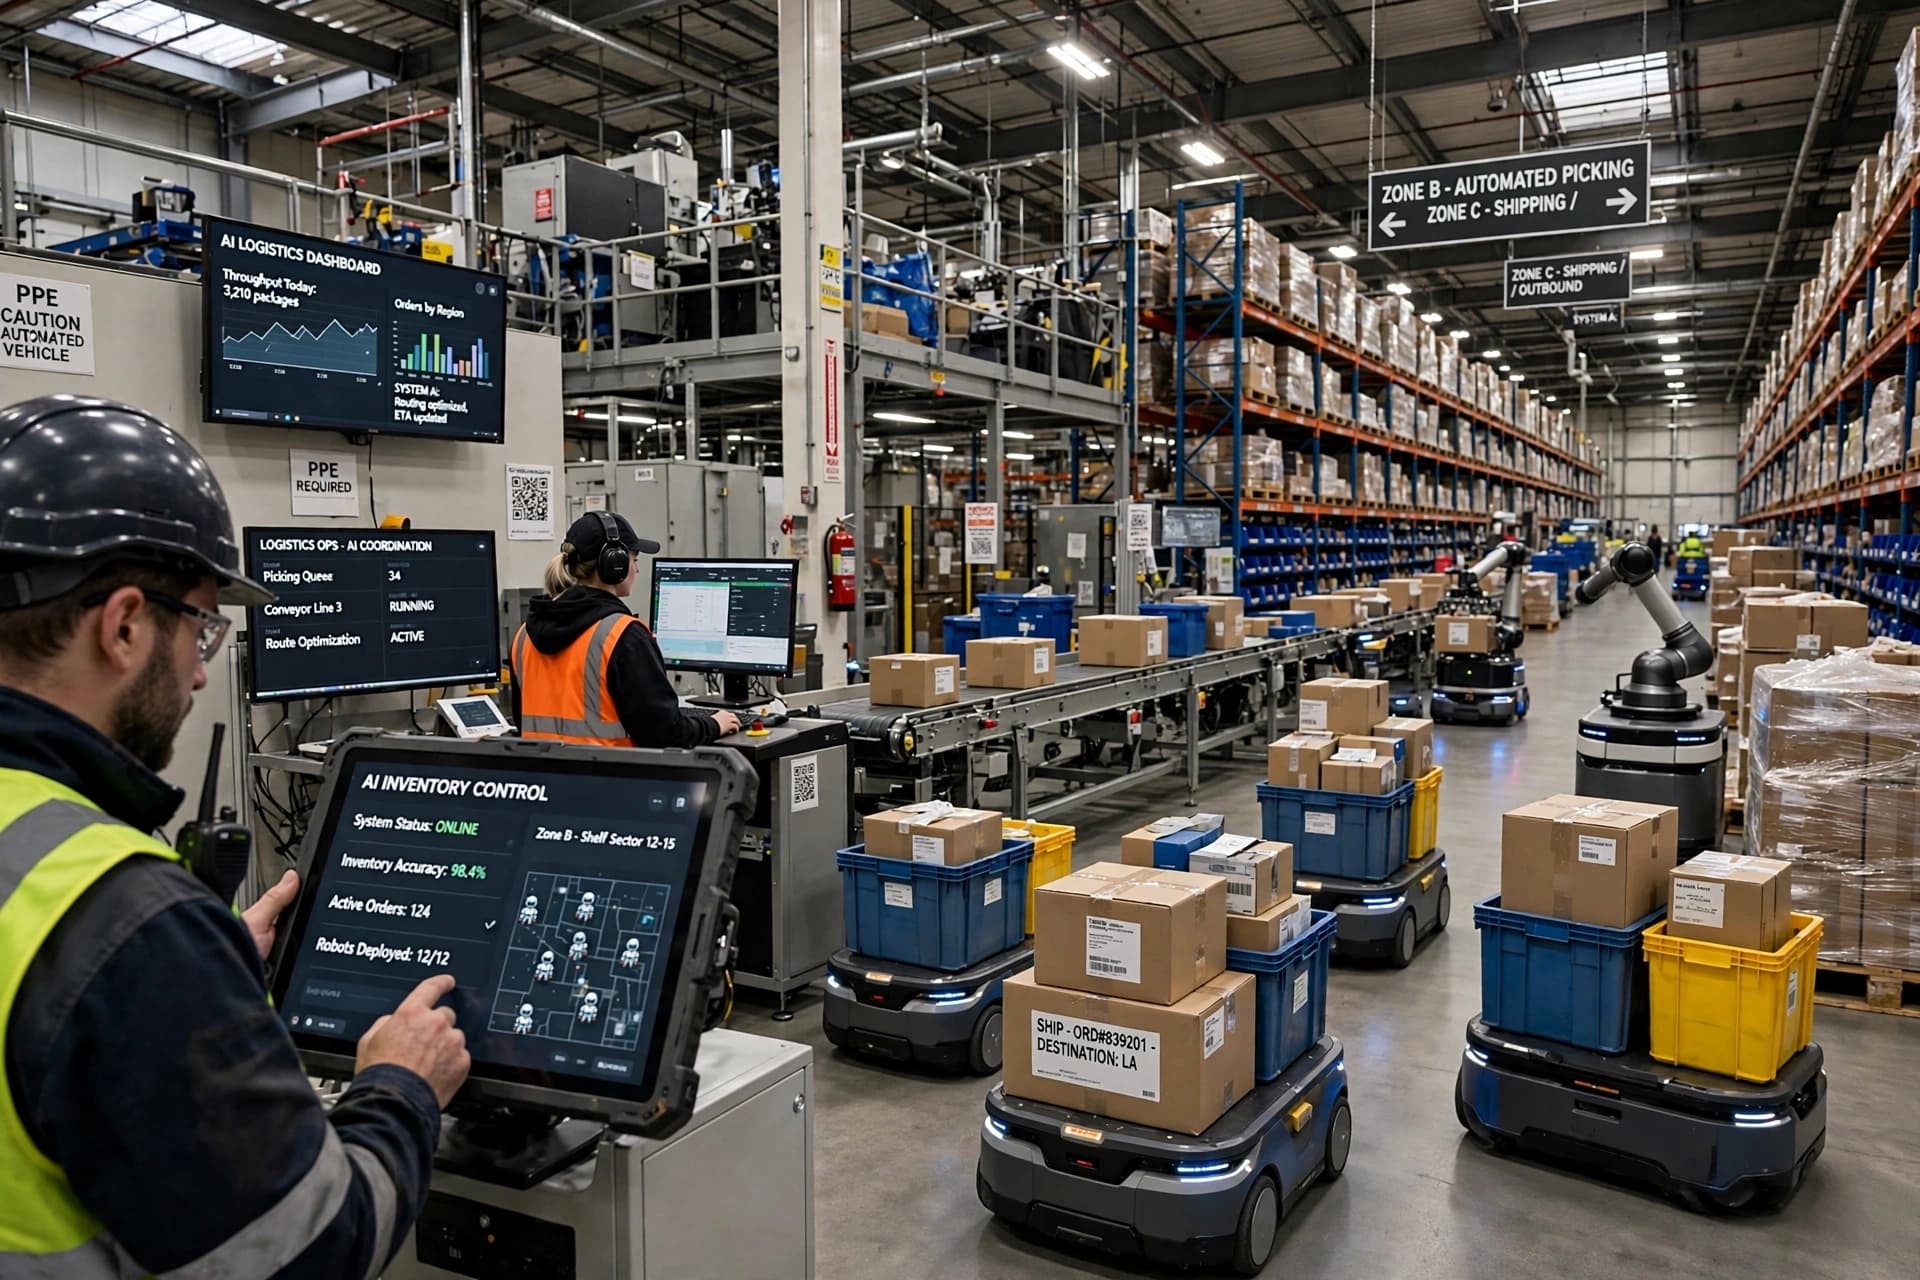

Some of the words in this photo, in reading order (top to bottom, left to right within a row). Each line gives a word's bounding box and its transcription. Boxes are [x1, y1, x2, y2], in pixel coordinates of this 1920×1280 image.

[1382, 182, 1424, 204] ZONE
[1430, 180, 1440, 199] B
[1454, 168, 1557, 196] AUTOMATED
[1562, 158, 1634, 184] PICKING
[1427, 206, 1467, 223] ZONE
[1471, 201, 1480, 219] C
[1494, 193, 1566, 216] SHIPPING
[1570, 190, 1578, 211] /
[220, 234, 234, 248] AI
[238, 236, 303, 261] LOGISTICS
[306, 251, 381, 275] DASHBOARD
[1512, 267, 1542, 281] ZONE
[1545, 266, 1554, 279] C
[1563, 262, 1617, 277] SHIPPING
[1619, 258, 1626, 274] /
[222, 268, 283, 288] Throughput
[283, 278, 317, 296] Today:
[1510, 284, 1517, 298] /
[1518, 280, 1583, 296] OUTBOUND
[17, 284, 58, 307] PPE
[223, 285, 251, 300] 3,210
[1, 307, 80, 331] CAUTION
[394, 299, 422, 312] Orders
[424, 302, 435, 316] by
[437, 304, 464, 319] Region
[3, 342, 70, 362] VEHICLE
[394, 383, 429, 396] SYSTEM
[394, 396, 426, 412] Routing
[394, 410, 412, 421] ETA
[308, 461, 338, 478] PPE
[296, 480, 352, 493] REQUIRED
[260, 539, 315, 551] LOGISTICS
[317, 540, 339, 551] OPS
[347, 540, 358, 551] AI
[360, 540, 432, 552] COORDINATION
[263, 570, 300, 585] Picking
[388, 570, 401, 581] 34
[264, 604, 312, 617] Conveyor
[314, 602, 334, 614] Line
[336, 601, 342, 613] 3
[389, 600, 434, 612] RUNNING
[266, 637, 296, 649] Route
[298, 632, 361, 650] Optimization
[390, 630, 424, 643] ACTIVE
[361, 774, 380, 789] AI
[382, 775, 471, 796] INVENTORY
[472, 782, 548, 801] CONTROL
[353, 813, 393, 830] System
[394, 817, 433, 832] Status:
[435, 820, 479, 836] ONLINE
[536, 827, 562, 840] Zone
[563, 829, 573, 841] B
[580, 830, 608, 844] Shelf
[609, 833, 644, 847] Sector
[645, 836, 676, 850] 12-15
[341, 853, 393, 874] Inventory
[394, 858, 448, 879] Accuracy:
[450, 864, 487, 880] 98.4%
[328, 894, 363, 911] Active
[365, 899, 408, 916] Orders:
[410, 903, 431, 918] 124
[315, 936, 355, 955] Robots
[356, 942, 413, 963] Deployed:
[416, 949, 450, 966] 12/12
[1037, 1017, 1064, 1036] SHIP
[1073, 1024, 1146, 1052] ORD#839201
[1038, 1038, 1119, 1067] DESTINATION:
[1122, 1054, 1137, 1071] LA
